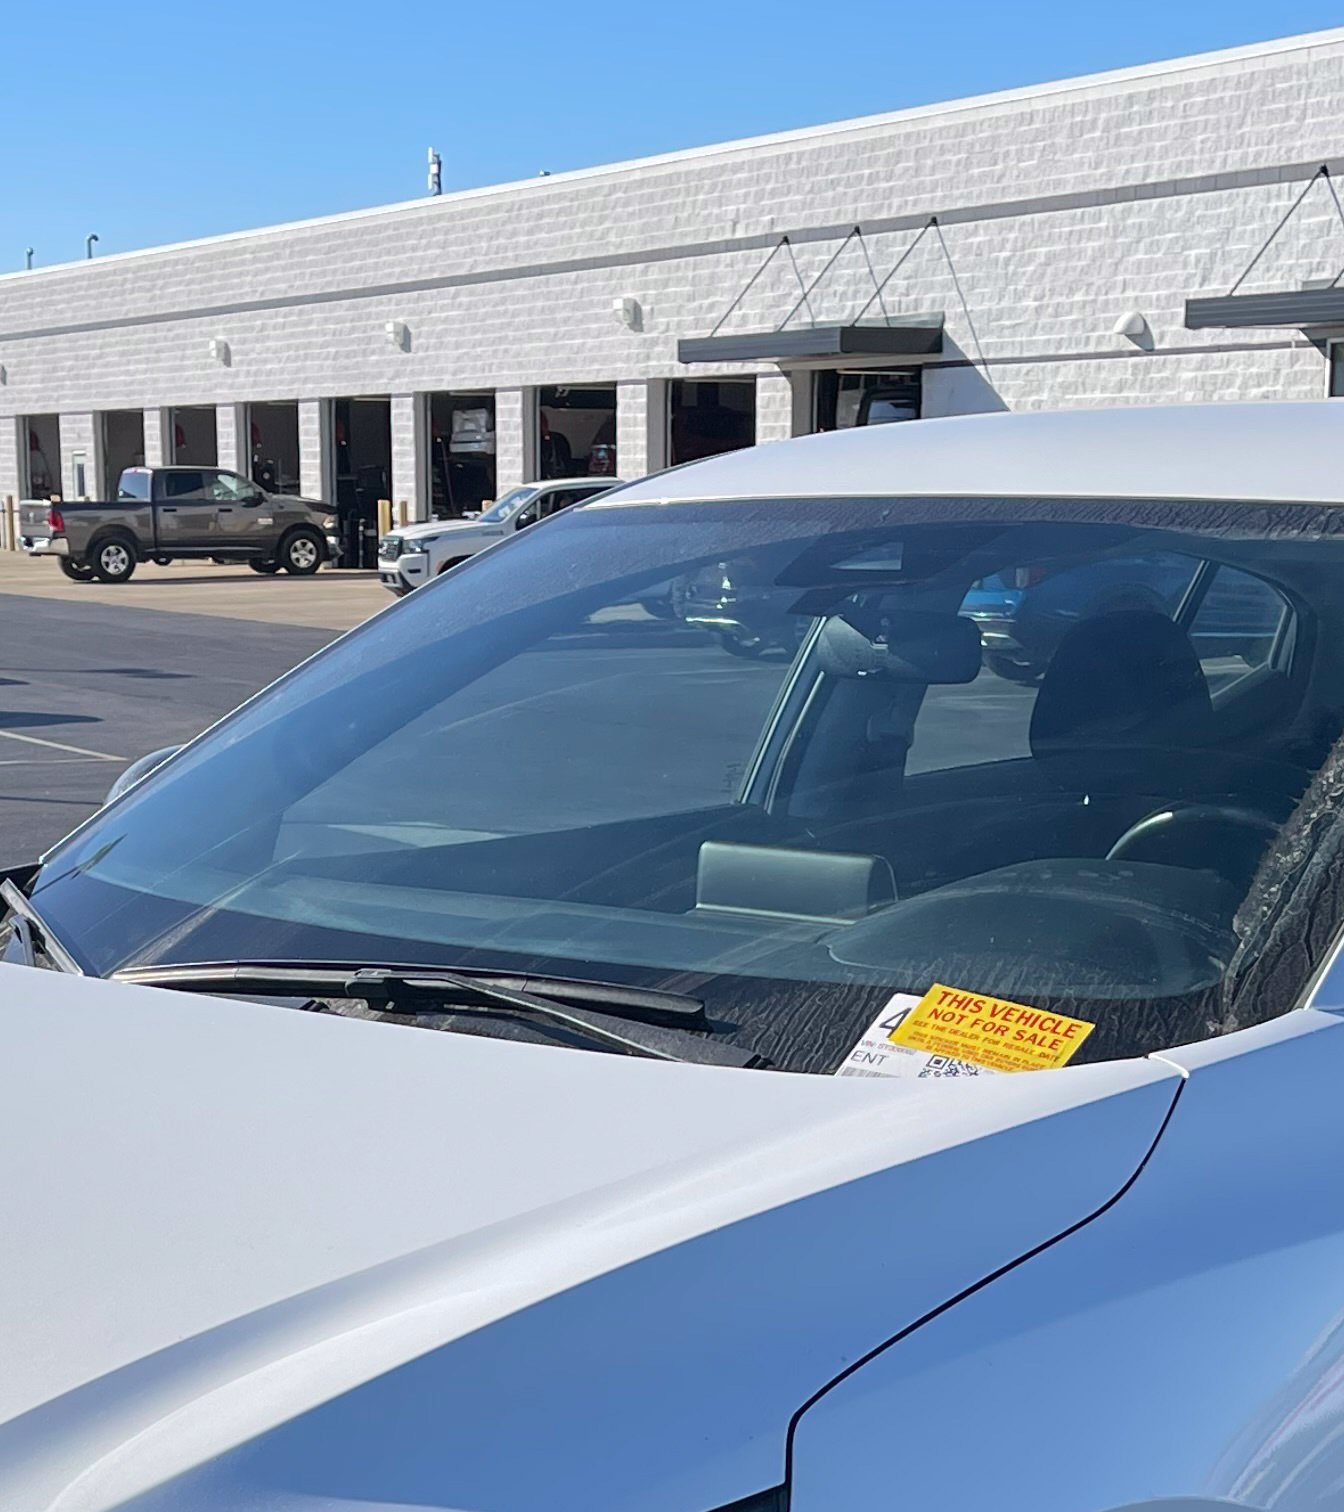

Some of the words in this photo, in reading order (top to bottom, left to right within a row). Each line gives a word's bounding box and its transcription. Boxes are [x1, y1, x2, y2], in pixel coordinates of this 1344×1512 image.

[926, 1007, 970, 1025] NOT
[970, 1017, 1010, 1037] FOR
[1012, 1029, 1064, 1051] SALE
[936, 991, 986, 1014] THIS
[989, 1003, 1083, 1039] VEHICLE
[931, 1024, 948, 1034] THE
[948, 1028, 981, 1042] DEALER
[981, 1036, 1001, 1046] FOR
[850, 1050, 887, 1066] ENT
